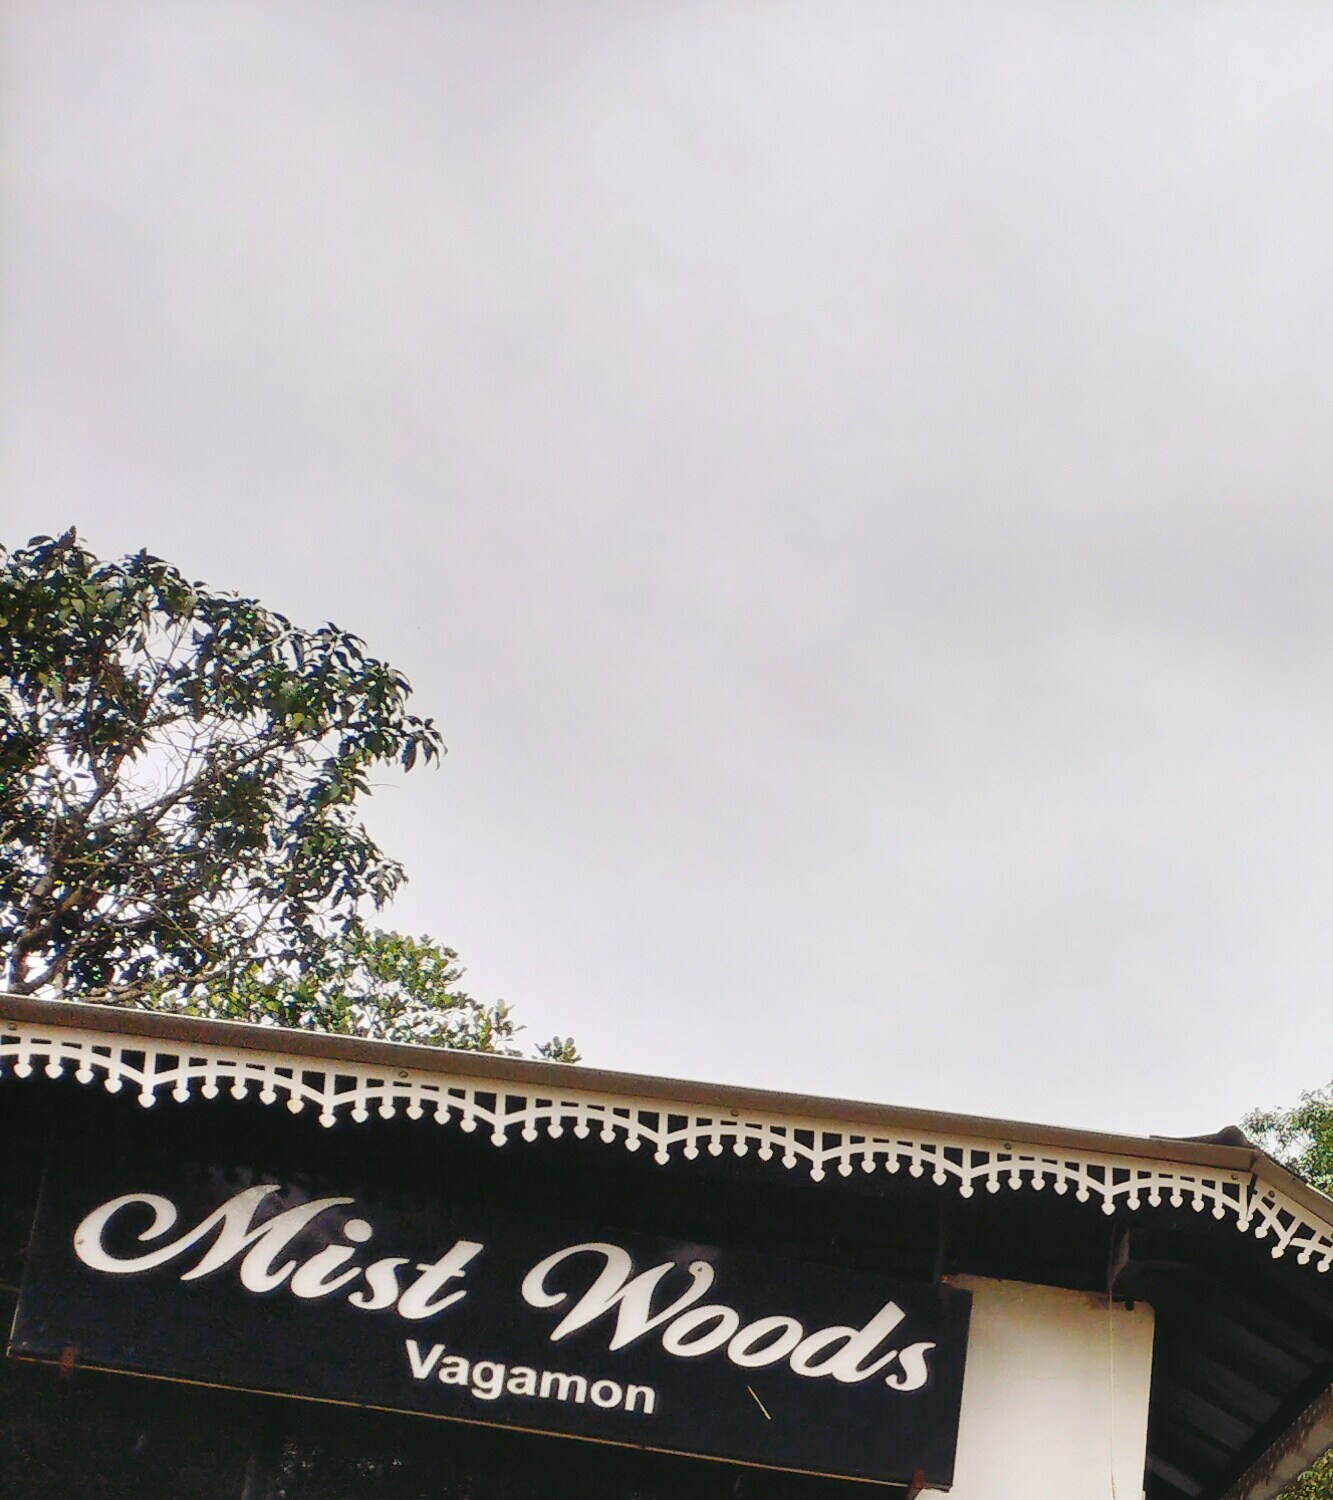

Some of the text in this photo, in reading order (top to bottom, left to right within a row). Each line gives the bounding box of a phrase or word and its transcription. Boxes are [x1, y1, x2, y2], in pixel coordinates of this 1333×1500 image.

[73, 1183, 937, 1392] Mist Woods
[405, 1339, 656, 1415] Vagamon
